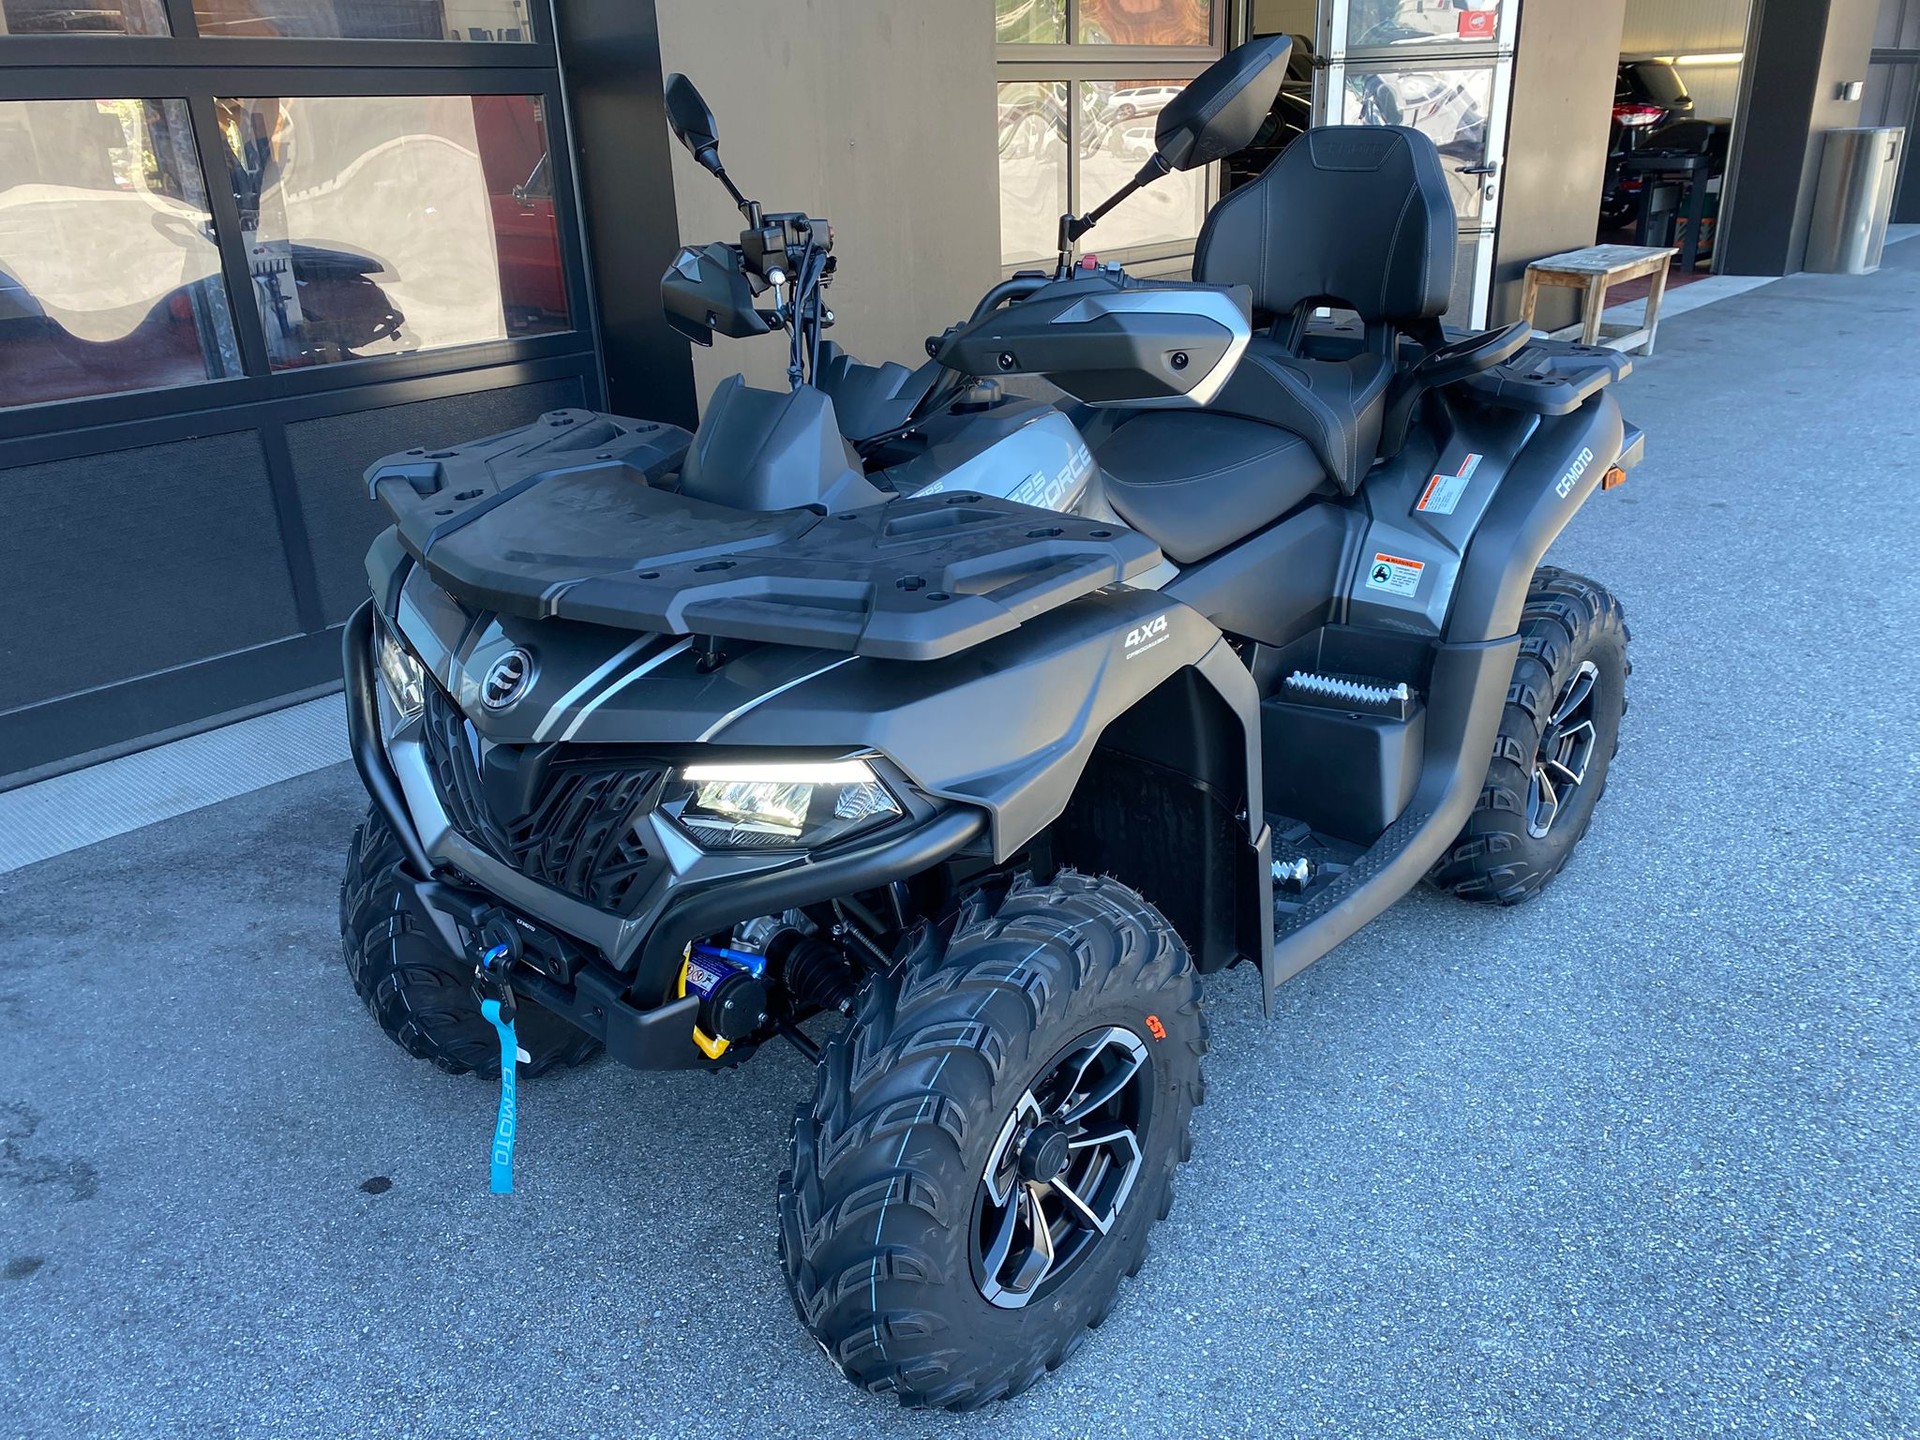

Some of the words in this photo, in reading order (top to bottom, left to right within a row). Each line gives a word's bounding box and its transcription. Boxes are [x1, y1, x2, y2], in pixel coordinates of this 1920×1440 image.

[1029, 442, 1092, 508] FORCE
[1555, 446, 1595, 499] CFMOTO
[1145, 1014, 1167, 1038] CST
[494, 1066, 514, 1166] CFMOTO
